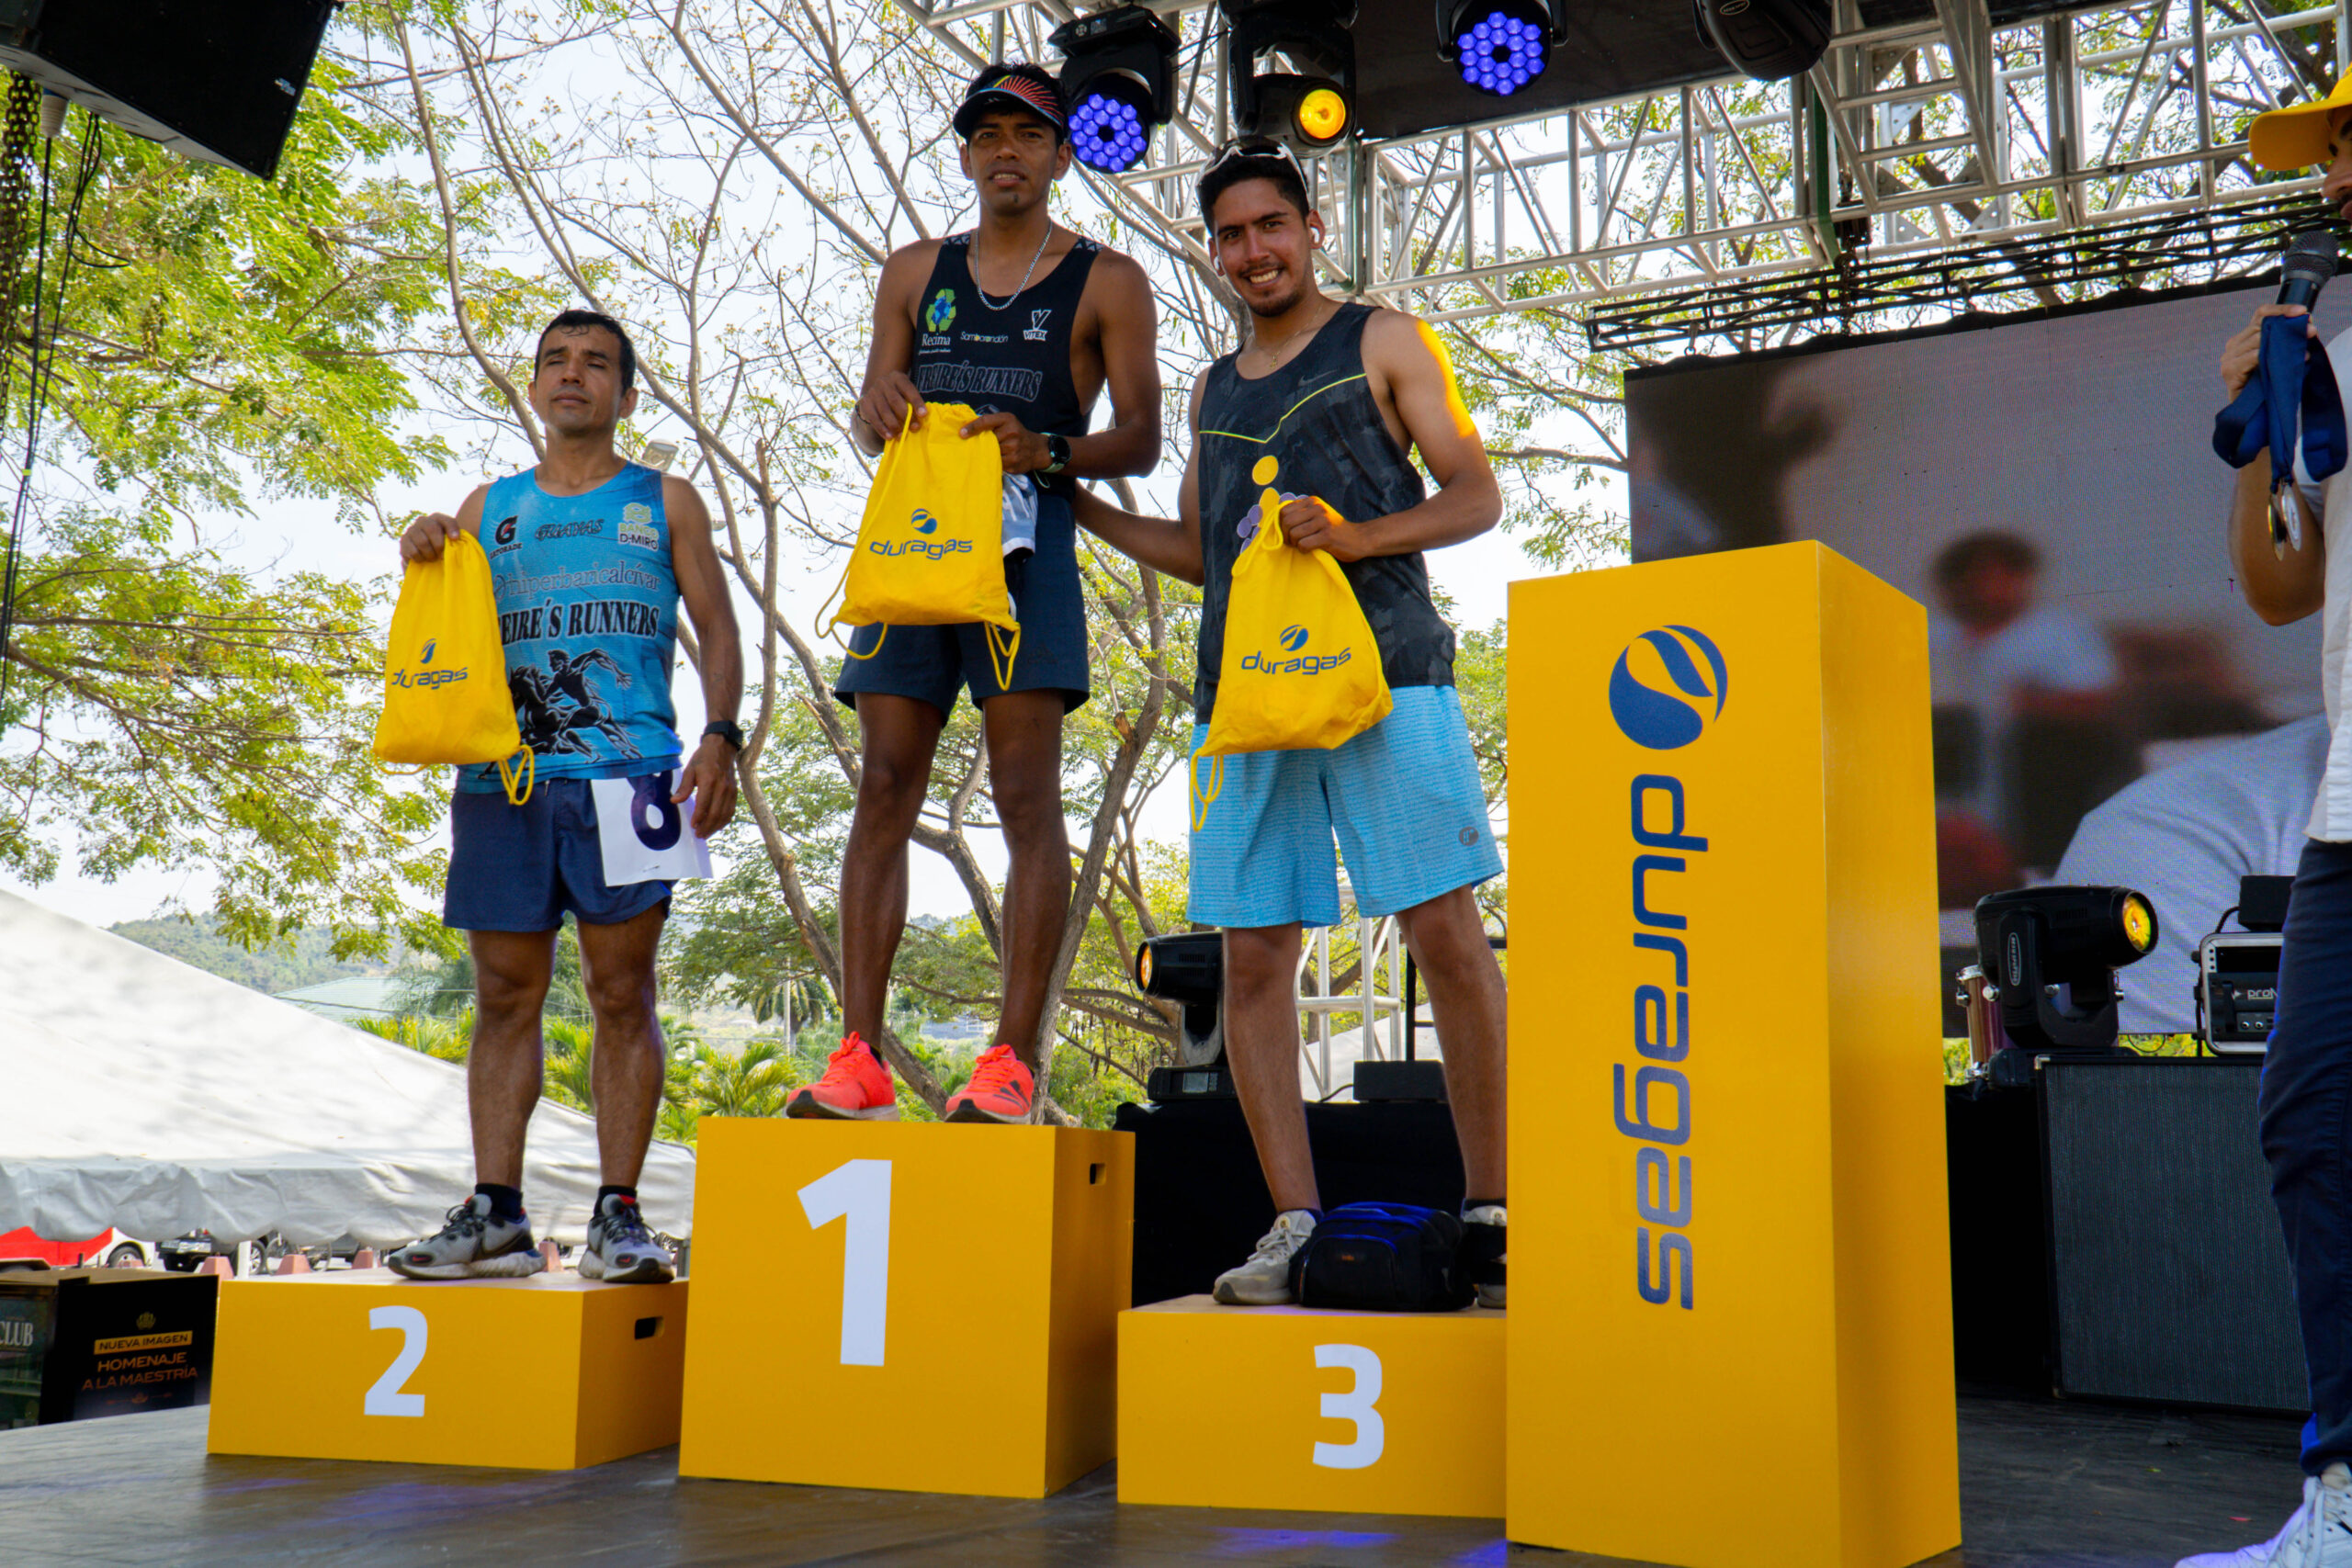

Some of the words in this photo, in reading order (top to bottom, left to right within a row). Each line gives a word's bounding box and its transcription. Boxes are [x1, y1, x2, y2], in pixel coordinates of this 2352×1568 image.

[922, 333, 951, 346] Recima
[969, 367, 1043, 402] RUNNERS
[535, 518, 605, 541] GUAYAS
[619, 523, 659, 539] BANCO
[619, 533, 658, 550] D-MIRO
[869, 538, 973, 561] duragas
[567, 601, 661, 638] RUNNERS
[1240, 647, 1352, 676] duragas
[1612, 773, 1708, 1311] duragas
[797, 1158, 892, 1367] 1
[98, 1338, 141, 1350] NUEVA
[142, 1334, 188, 1346] IMAGEN
[97, 1352, 187, 1372] HOMENAJE
[364, 1305, 428, 1417] 2
[81, 1379, 93, 1391] A
[96, 1375, 118, 1390] LA
[119, 1366, 198, 1386] MAESTRÍA
[1312, 1343, 1385, 1470] 3
